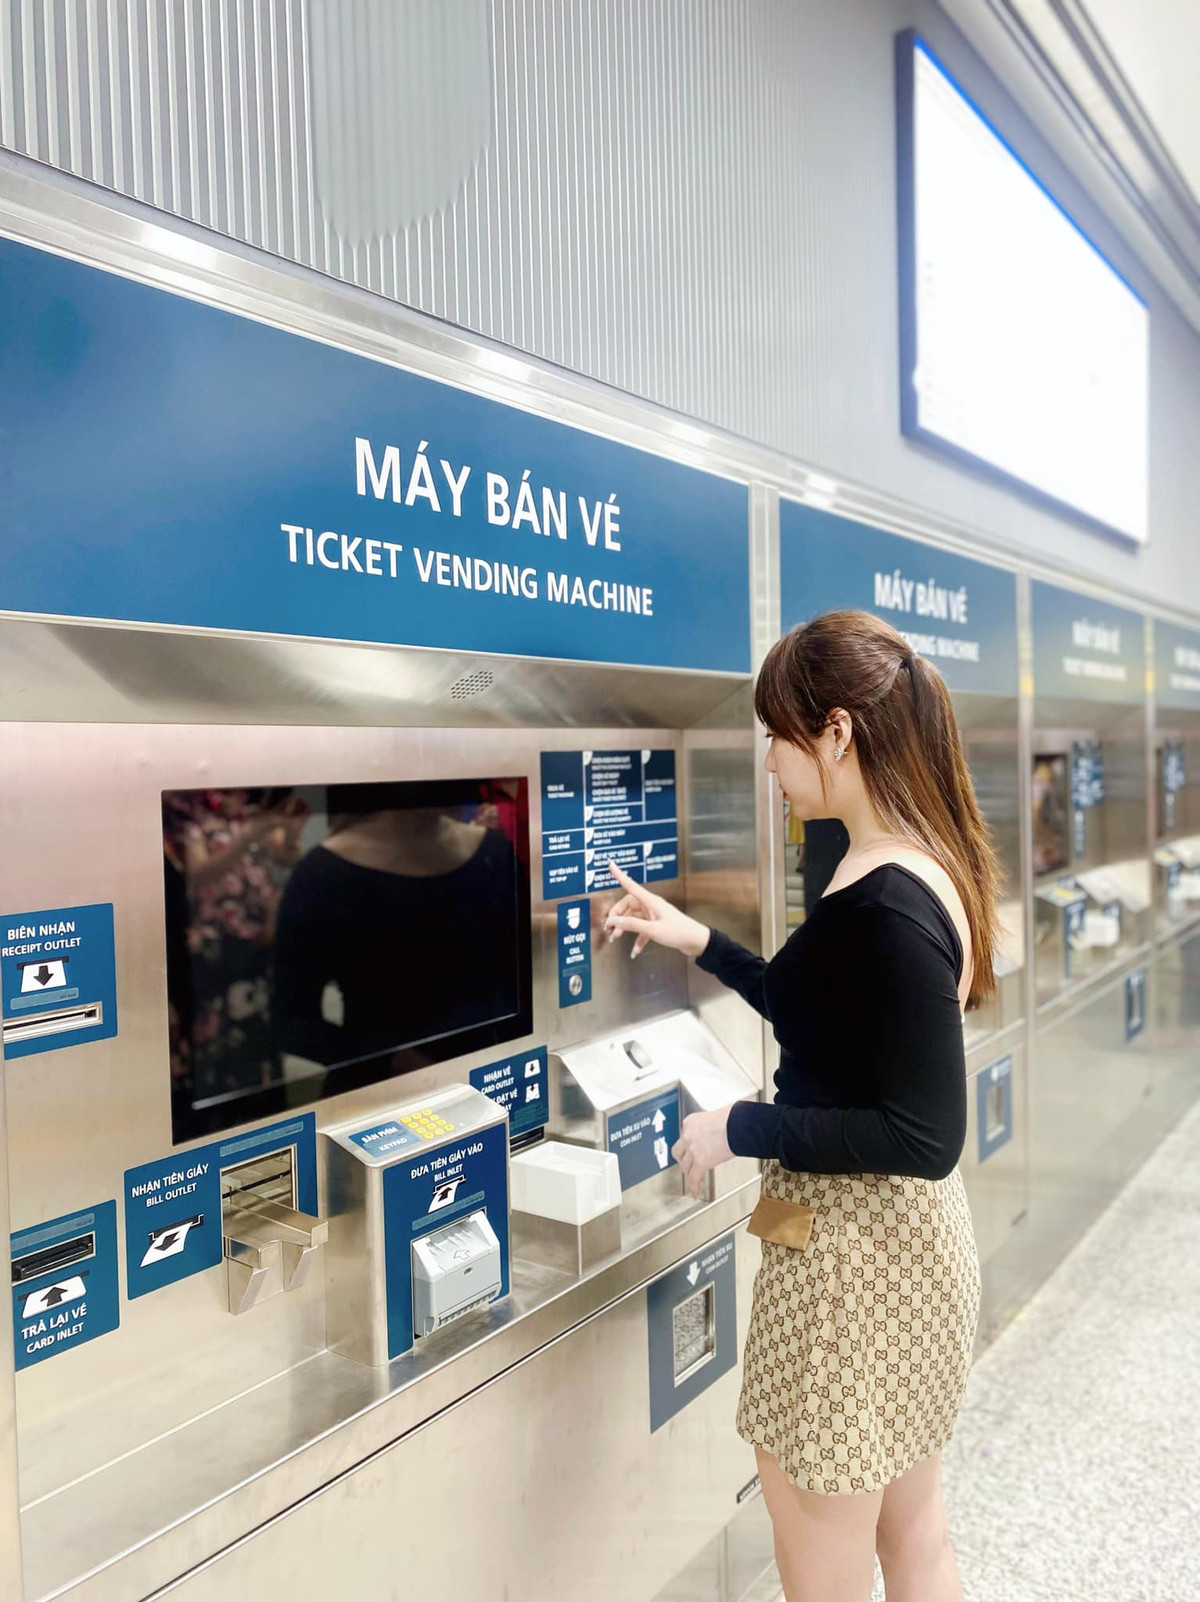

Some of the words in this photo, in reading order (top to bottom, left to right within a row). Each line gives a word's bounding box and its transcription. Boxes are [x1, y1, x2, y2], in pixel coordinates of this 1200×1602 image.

[355, 437, 471, 517] MÁY
[486, 469, 568, 540] BÁN
[578, 493, 621, 551] VÉ
[280, 523, 402, 578] TICKET
[413, 547, 538, 599] VENDING
[547, 572, 653, 616] MACHINE
[874, 569, 914, 613] MÁY
[916, 577, 948, 620] BÁN
[948, 585, 967, 624] VÉ
[7, 925, 35, 941] BIÊN
[1, 943, 41, 957] RECEIPT
[44, 937, 82, 951] OUTLET
[481, 1085, 495, 1095] CARD
[495, 1077, 514, 1089] OUTLET
[379, 1138, 408, 1151] KEYPAD
[410, 1167, 429, 1179] ĐƯA
[466, 1142, 484, 1156] VÀO
[434, 1171, 446, 1182] BILL
[446, 1163, 463, 1176] INLET
[146, 1195, 163, 1208] BILL
[165, 1182, 197, 1201] OUTLET
[49, 1311, 69, 1329] LẠI
[71, 1302, 87, 1320] VÉ
[26, 1335, 55, 1354] CARD
[56, 1322, 84, 1341] INLET
